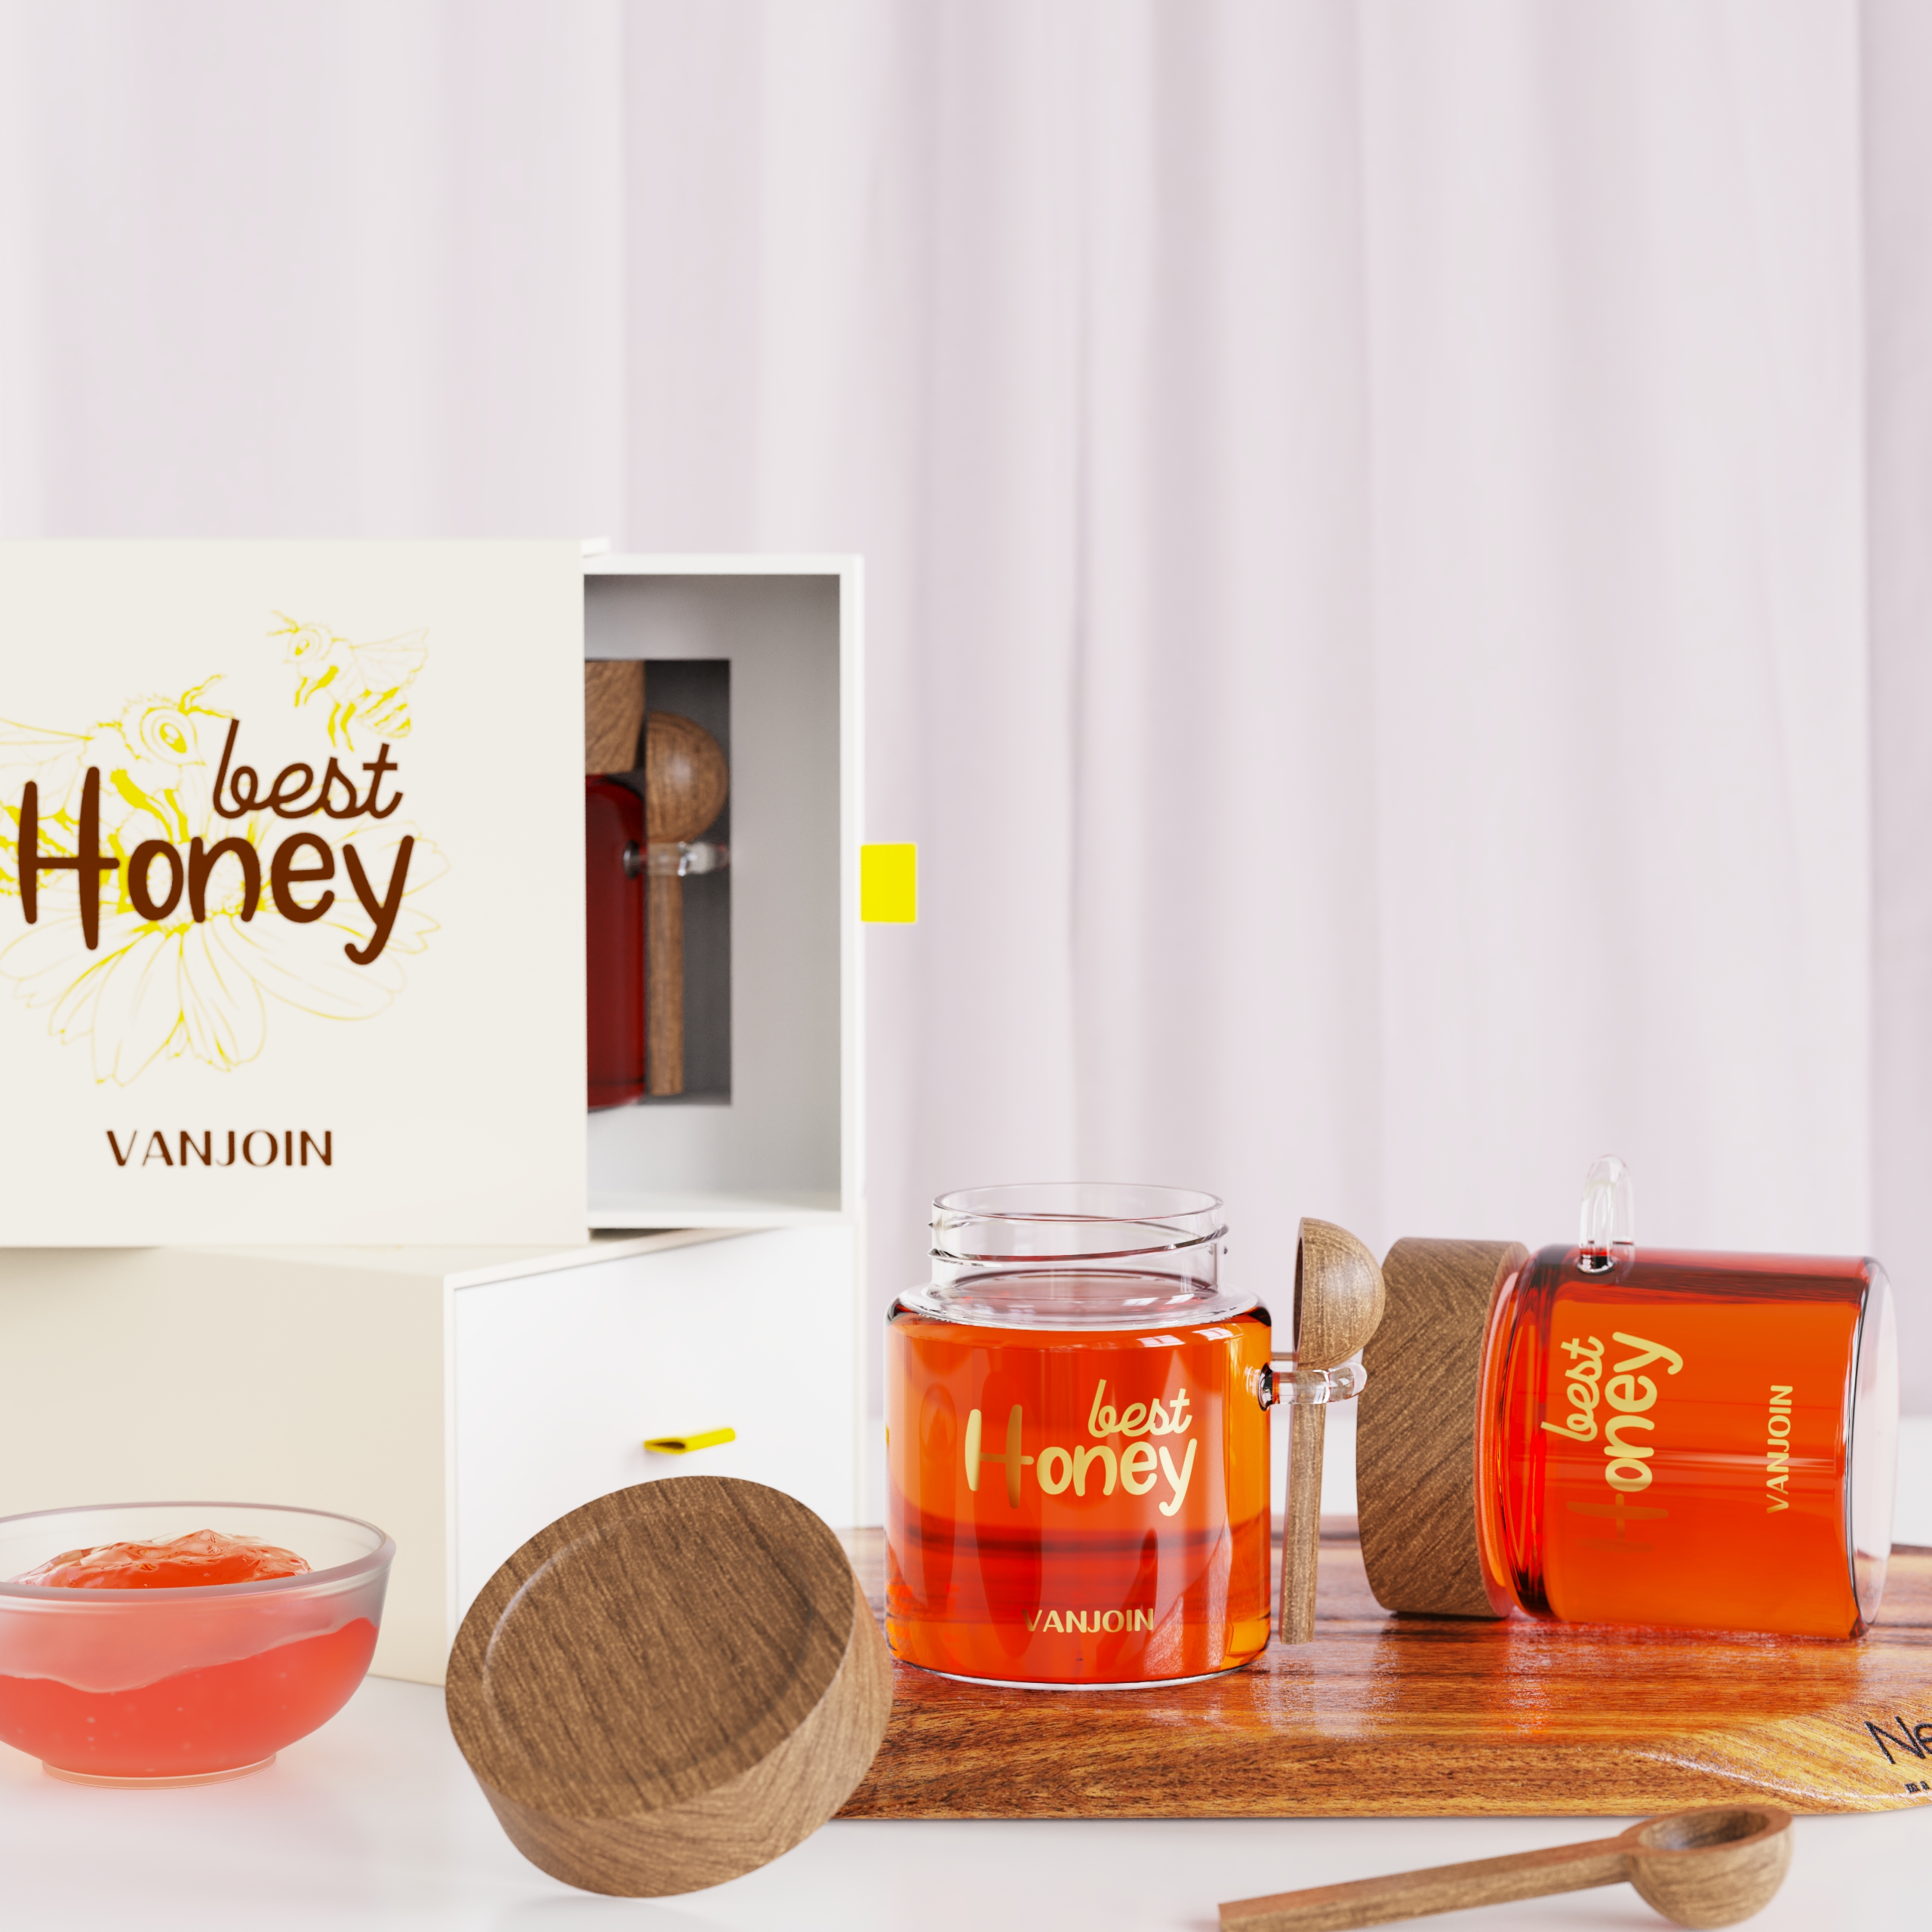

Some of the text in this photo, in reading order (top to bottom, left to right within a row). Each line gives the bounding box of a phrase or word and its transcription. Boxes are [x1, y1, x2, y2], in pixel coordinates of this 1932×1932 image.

[213, 718, 403, 819] best
[18, 767, 414, 965] Honey
[106, 1131, 333, 1167] VANJOIN
[1088, 1380, 1192, 1438] best
[1540, 1335, 1604, 1441] best
[964, 1404, 1198, 1516] Honey
[1566, 1331, 1684, 1553] Honey
[1766, 1384, 1793, 1514] VANJOIN
[1023, 1609, 1154, 1633] VANJOIN
